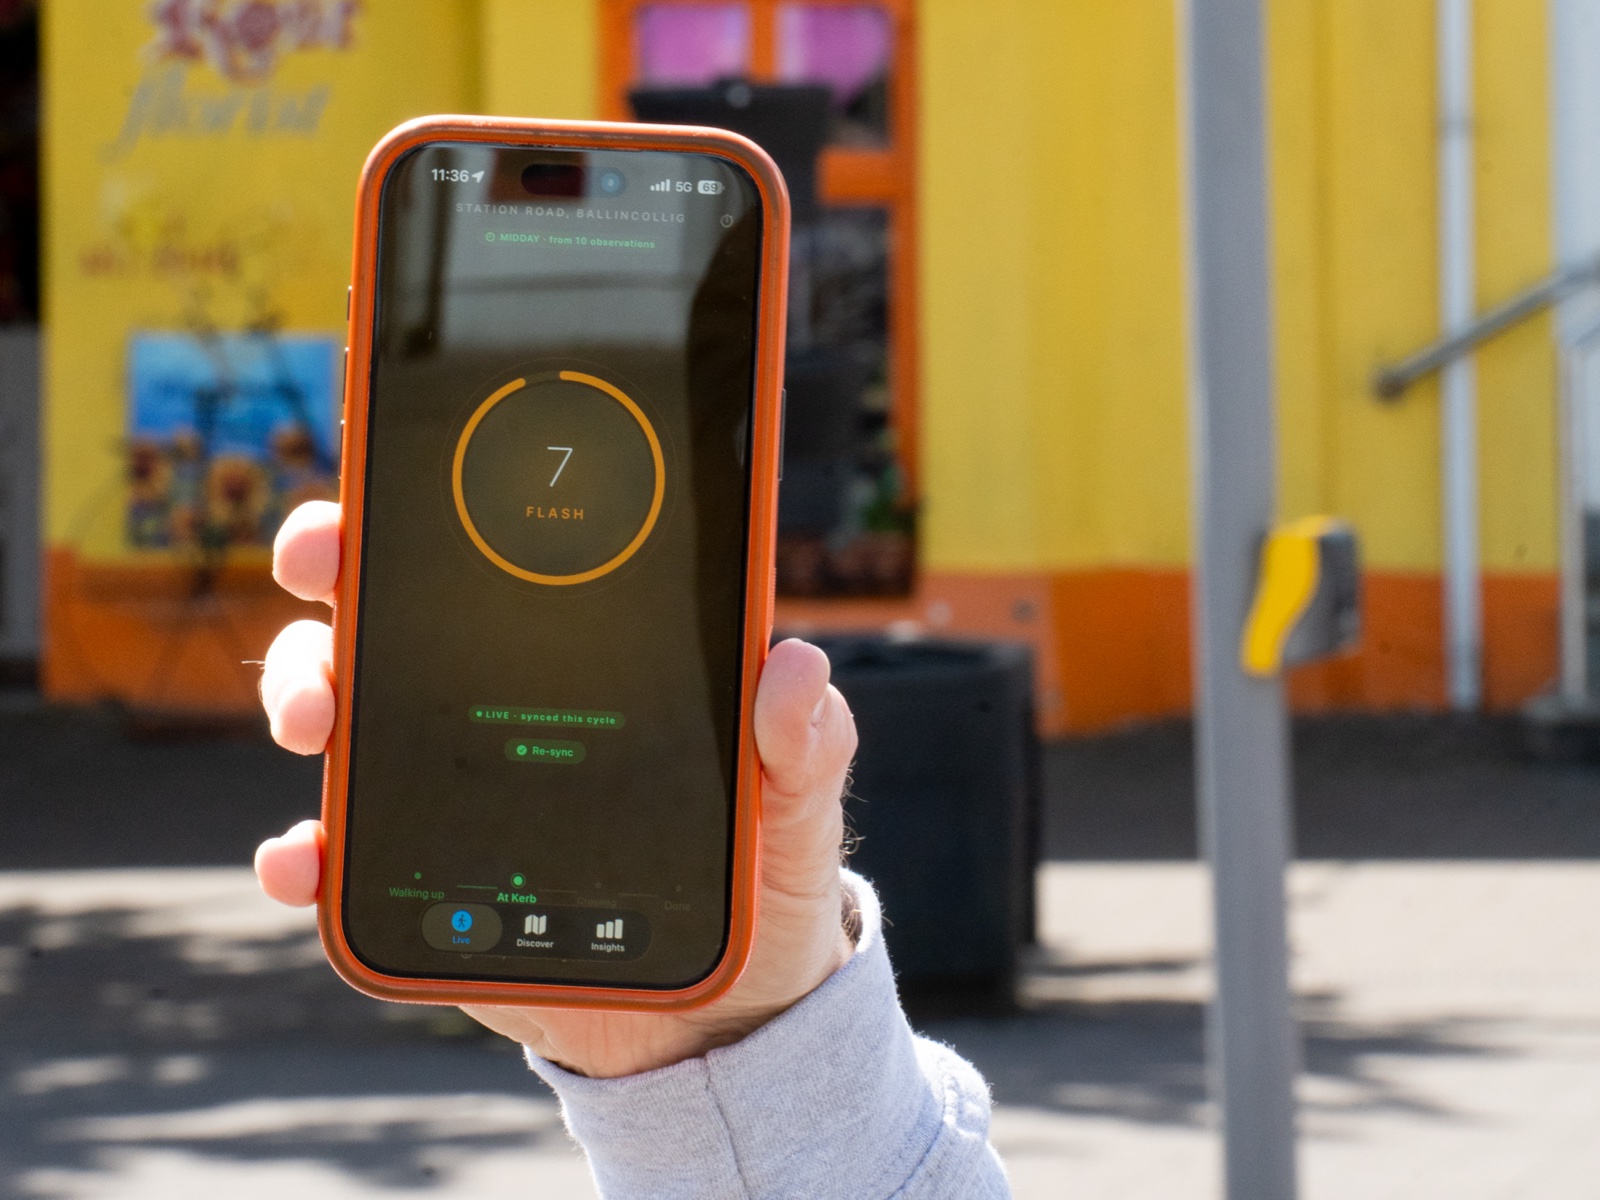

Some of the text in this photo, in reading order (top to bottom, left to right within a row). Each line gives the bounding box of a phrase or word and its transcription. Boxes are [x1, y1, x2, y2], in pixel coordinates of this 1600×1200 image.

[431, 168, 470, 183] 11:36
[675, 181, 718, 193] 5G 69
[455, 203, 685, 223] STATION ROAD, BALLINCOLLIG
[500, 233, 656, 249] MIDDAY from 10 observations
[547, 446, 573, 487] 7
[526, 506, 584, 520] FLASH
[485, 711, 616, 725] LIVE synced this cycle
[532, 746, 574, 759] Re-sync
[389, 887, 445, 900] Walking up
[497, 892, 537, 904] At Kerb
[452, 936, 471, 945] Live
[516, 938, 555, 949] Discover
[591, 942, 626, 954] Insights
